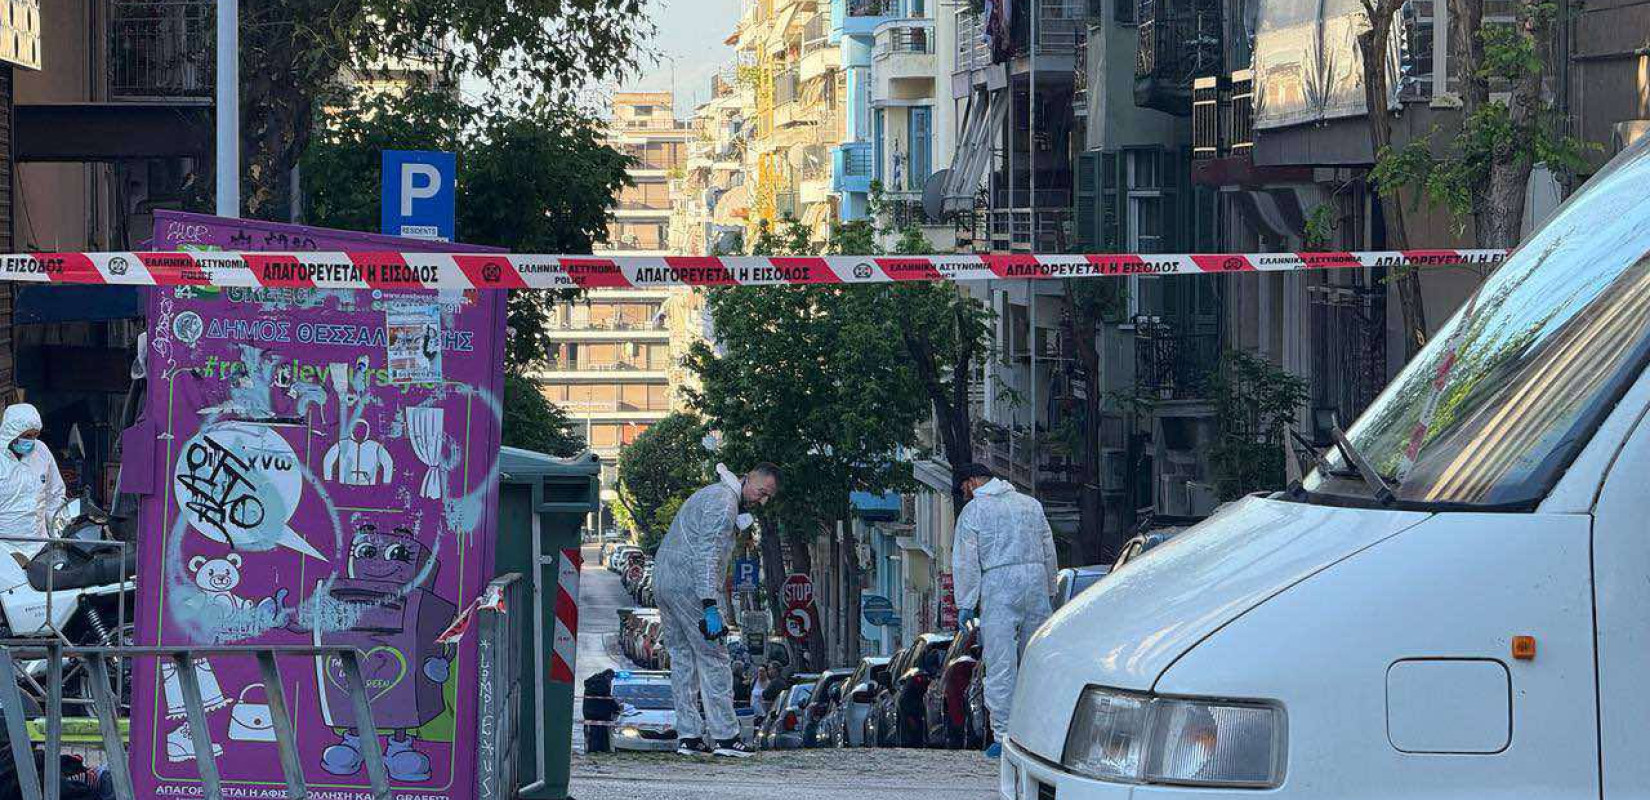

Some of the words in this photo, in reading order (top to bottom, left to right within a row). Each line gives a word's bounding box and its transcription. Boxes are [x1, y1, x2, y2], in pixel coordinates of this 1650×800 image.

[400, 162, 442, 217] P
[6, 257, 63, 273] ΕΙΣΟΔΟΣ
[145, 257, 193, 268] ΕΛΛΗΝΙΚΗ
[195, 258, 249, 270] ΑΣΤΥΝΟΜΙΑ
[519, 263, 565, 273] ΕΛΛΗΝΙΚΗ
[568, 263, 621, 273] ΑΣΤΥΝΟΜΙΑ
[889, 262, 936, 271] ΕΛΛΗΝΙΚΗ
[939, 261, 992, 271] ΑΣΤΥΝΟΜΙΑ
[1259, 257, 1307, 265] ΕΛΛΗΝΙΚΗ
[181, 270, 213, 281] POLICE
[263, 261, 363, 282] ΑΠΑΓΟΡΕΥΕΤΑΙ
[381, 264, 438, 283] ΕΙΣΟΔΟΣ
[635, 265, 736, 283] ΑΠΑΓΟΡΕΥΕΤΑΙ
[753, 266, 811, 281] ΕΙΣΟΔΟΣ
[1006, 262, 1105, 276] ΑΠΑΓΟΡΕΥΕΤΑΙ
[554, 275, 586, 285] POLICE
[205, 318, 290, 342] ΔΗΜΟΣ
[296, 322, 473, 351] ΘΕΣΣΑΛΗΣ
[740, 563, 753, 579] P
[785, 582, 812, 601] STOP
